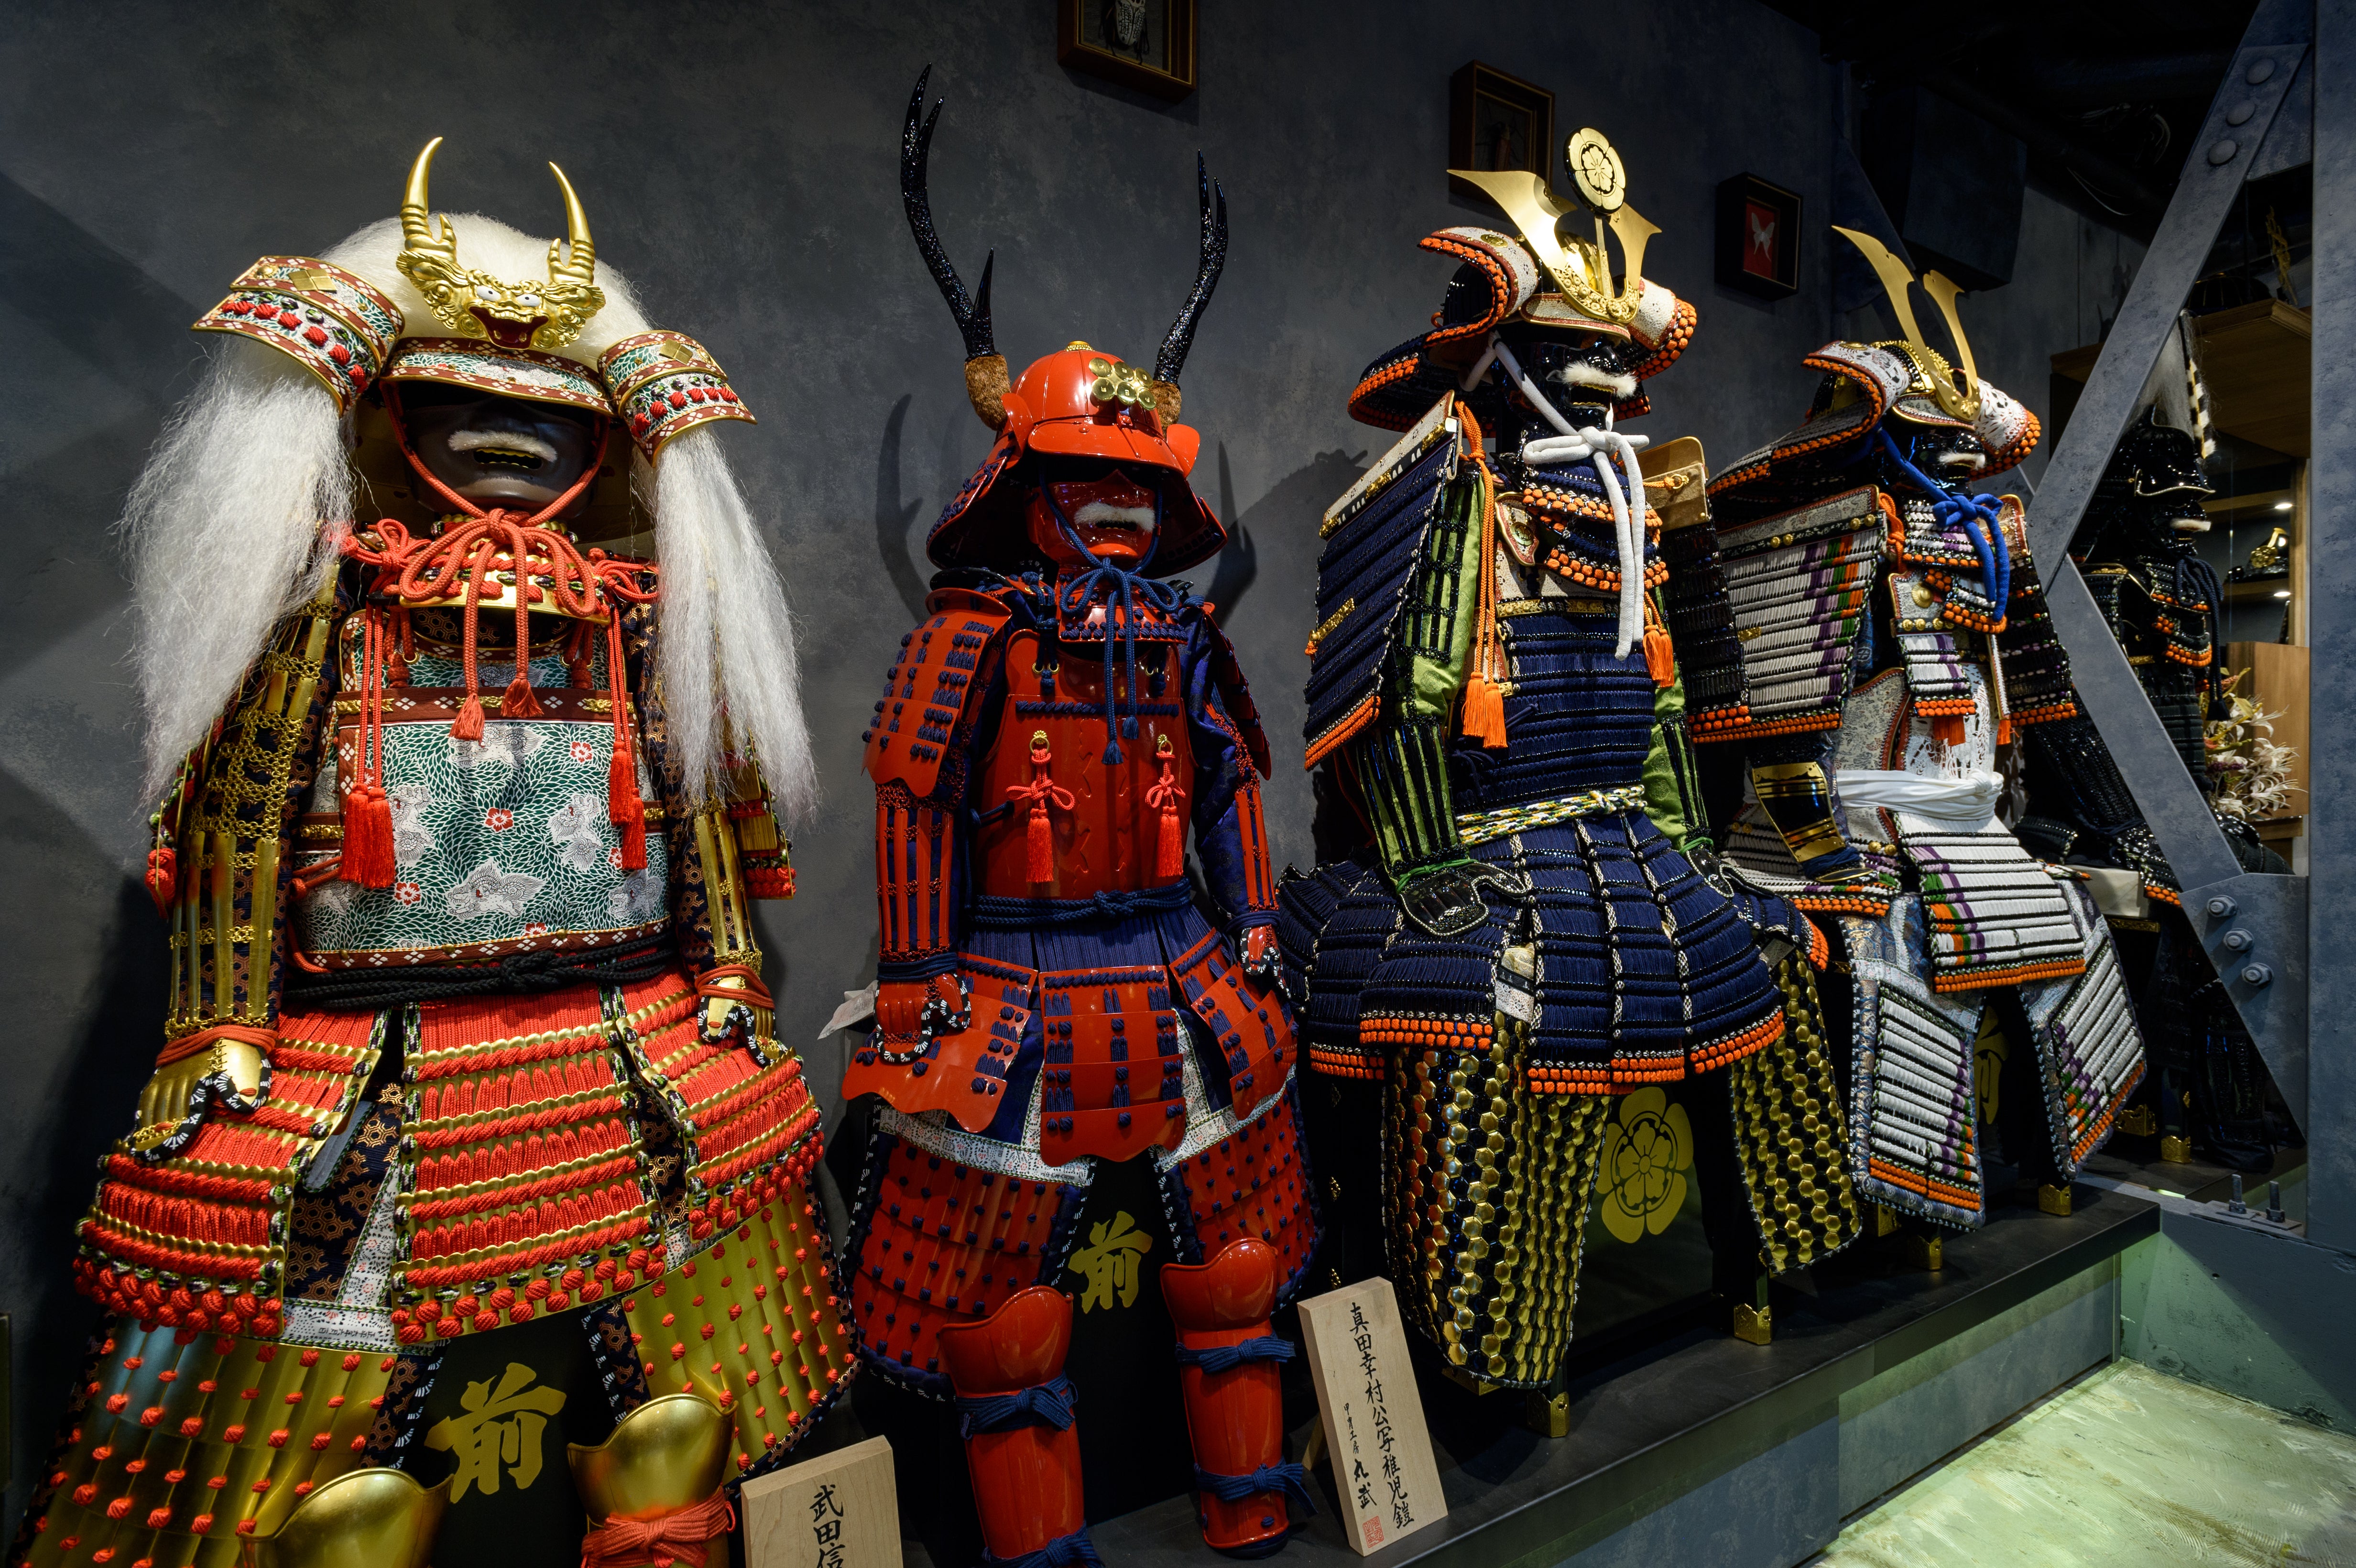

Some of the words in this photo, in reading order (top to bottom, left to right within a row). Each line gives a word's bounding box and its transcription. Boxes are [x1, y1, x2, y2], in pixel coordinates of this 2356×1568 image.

[1068, 1210, 1153, 1314] 前
[424, 1362, 567, 1504] 前
[1349, 1302, 1414, 1529] 真田幸村公写稚児鎧
[809, 1484, 846, 1568] 武田信
